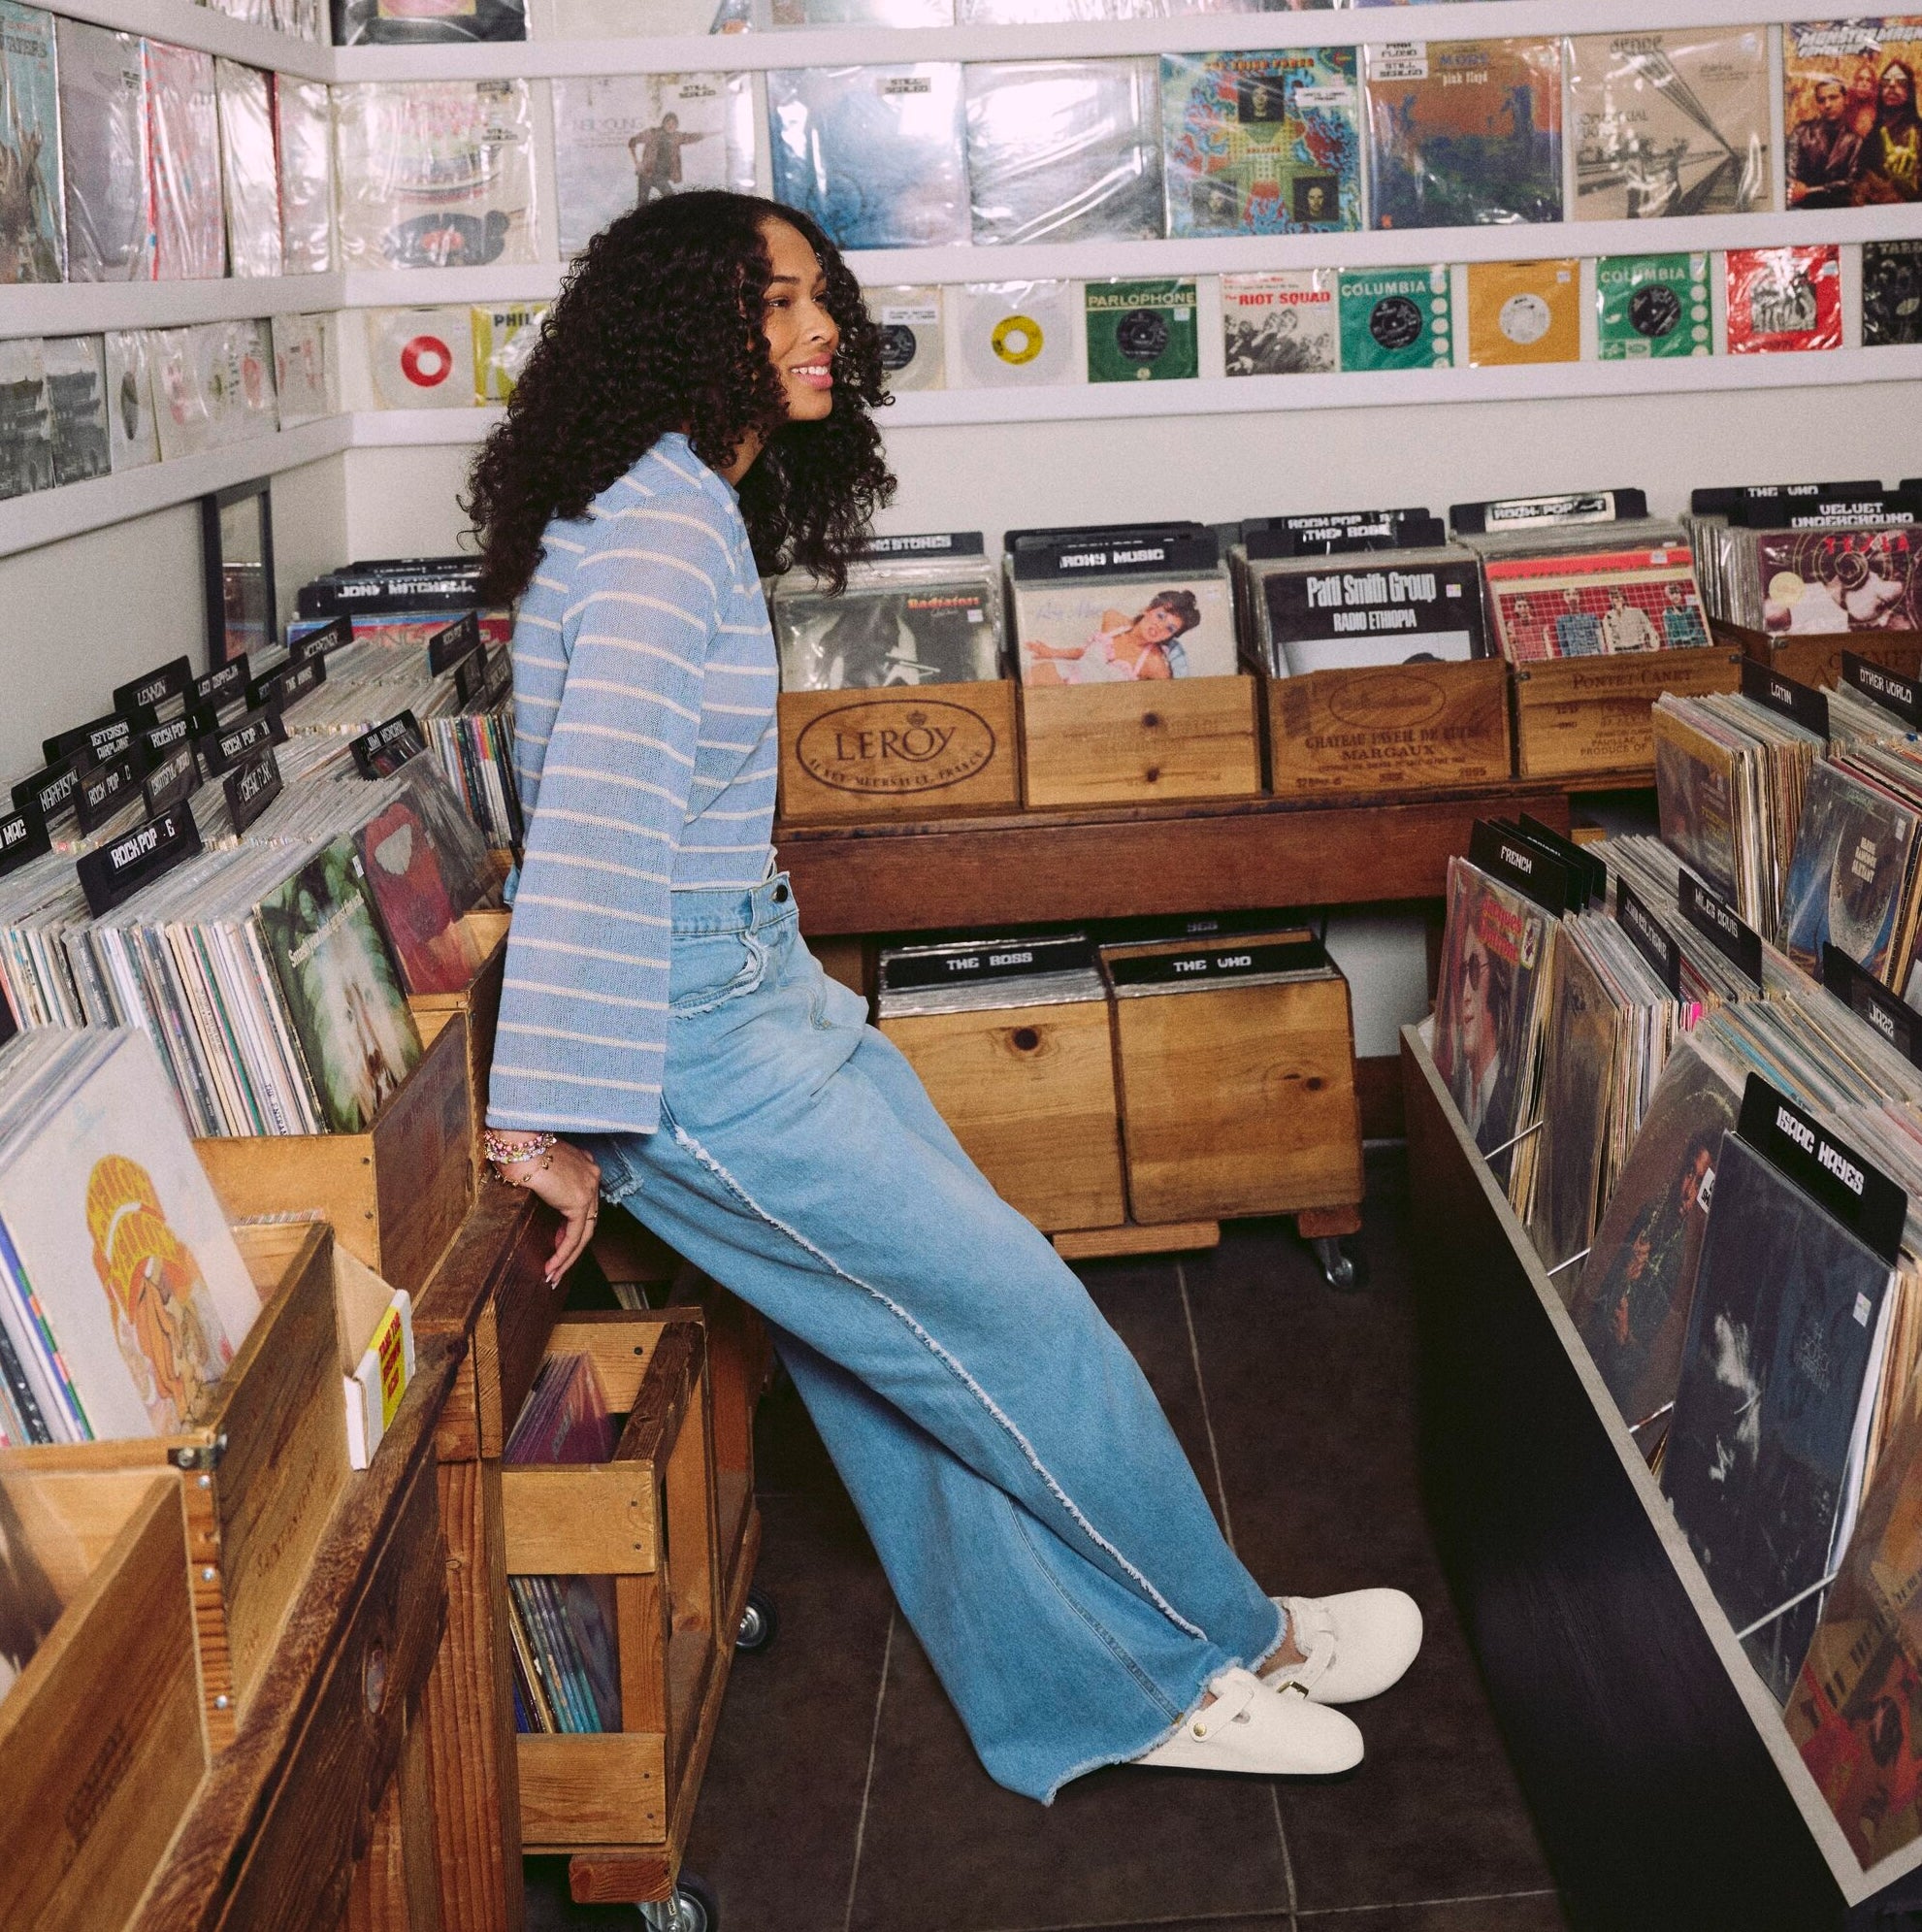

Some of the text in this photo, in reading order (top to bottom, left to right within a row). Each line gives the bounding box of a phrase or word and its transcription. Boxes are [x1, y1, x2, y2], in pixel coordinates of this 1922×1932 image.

[1602, 268, 1685, 283] COLUMBIA
[1341, 280, 1426, 297] COLUMBIA
[1088, 291, 1195, 309] PARLOPHONE
[1239, 293, 1274, 307] RIOT
[1279, 291, 1331, 305] SQUAD
[494, 312, 534, 327] PHIL
[1747, 487, 1778, 498] THE
[1819, 503, 1884, 516] VELVET
[1287, 516, 1328, 530] ROCK
[1330, 514, 1362, 526] POP
[1791, 512, 1914, 529] UNDERGROUND
[892, 535, 953, 551] STONES
[1059, 547, 1164, 570] ROXY MUSIC
[338, 584, 380, 598] JONI
[1307, 571, 1437, 608] Patti Smith Group
[1333, 607, 1417, 633] RADIO ETHIOPIA
[1770, 681, 1793, 705] LATIN
[1859, 667, 1913, 704] OTHER WORLD
[150, 727, 173, 748] ROCK
[172, 721, 187, 740] POP
[220, 737, 242, 757] ROCK
[242, 728, 256, 746] POP
[835, 726, 957, 763] LEROY
[1342, 743, 1436, 761] MARGAUX
[1580, 743, 1648, 756] PRODUCE OF
[87, 783, 107, 807] ROCK
[106, 771, 119, 795] POP
[2, 819, 27, 845] MAC
[110, 839, 143, 869] ROCK
[138, 827, 158, 854] POP
[1500, 845, 1533, 874] FRENCH
[1187, 921, 1219, 933] YES
[946, 952, 1033, 970] THE BOSS
[1173, 955, 1252, 972] THE WHO
[1869, 1000, 1894, 1038] JAZZ
[271, 1099, 288, 1136] ENTRAN
[1775, 1105, 1865, 1195] ISAAC HAYES
